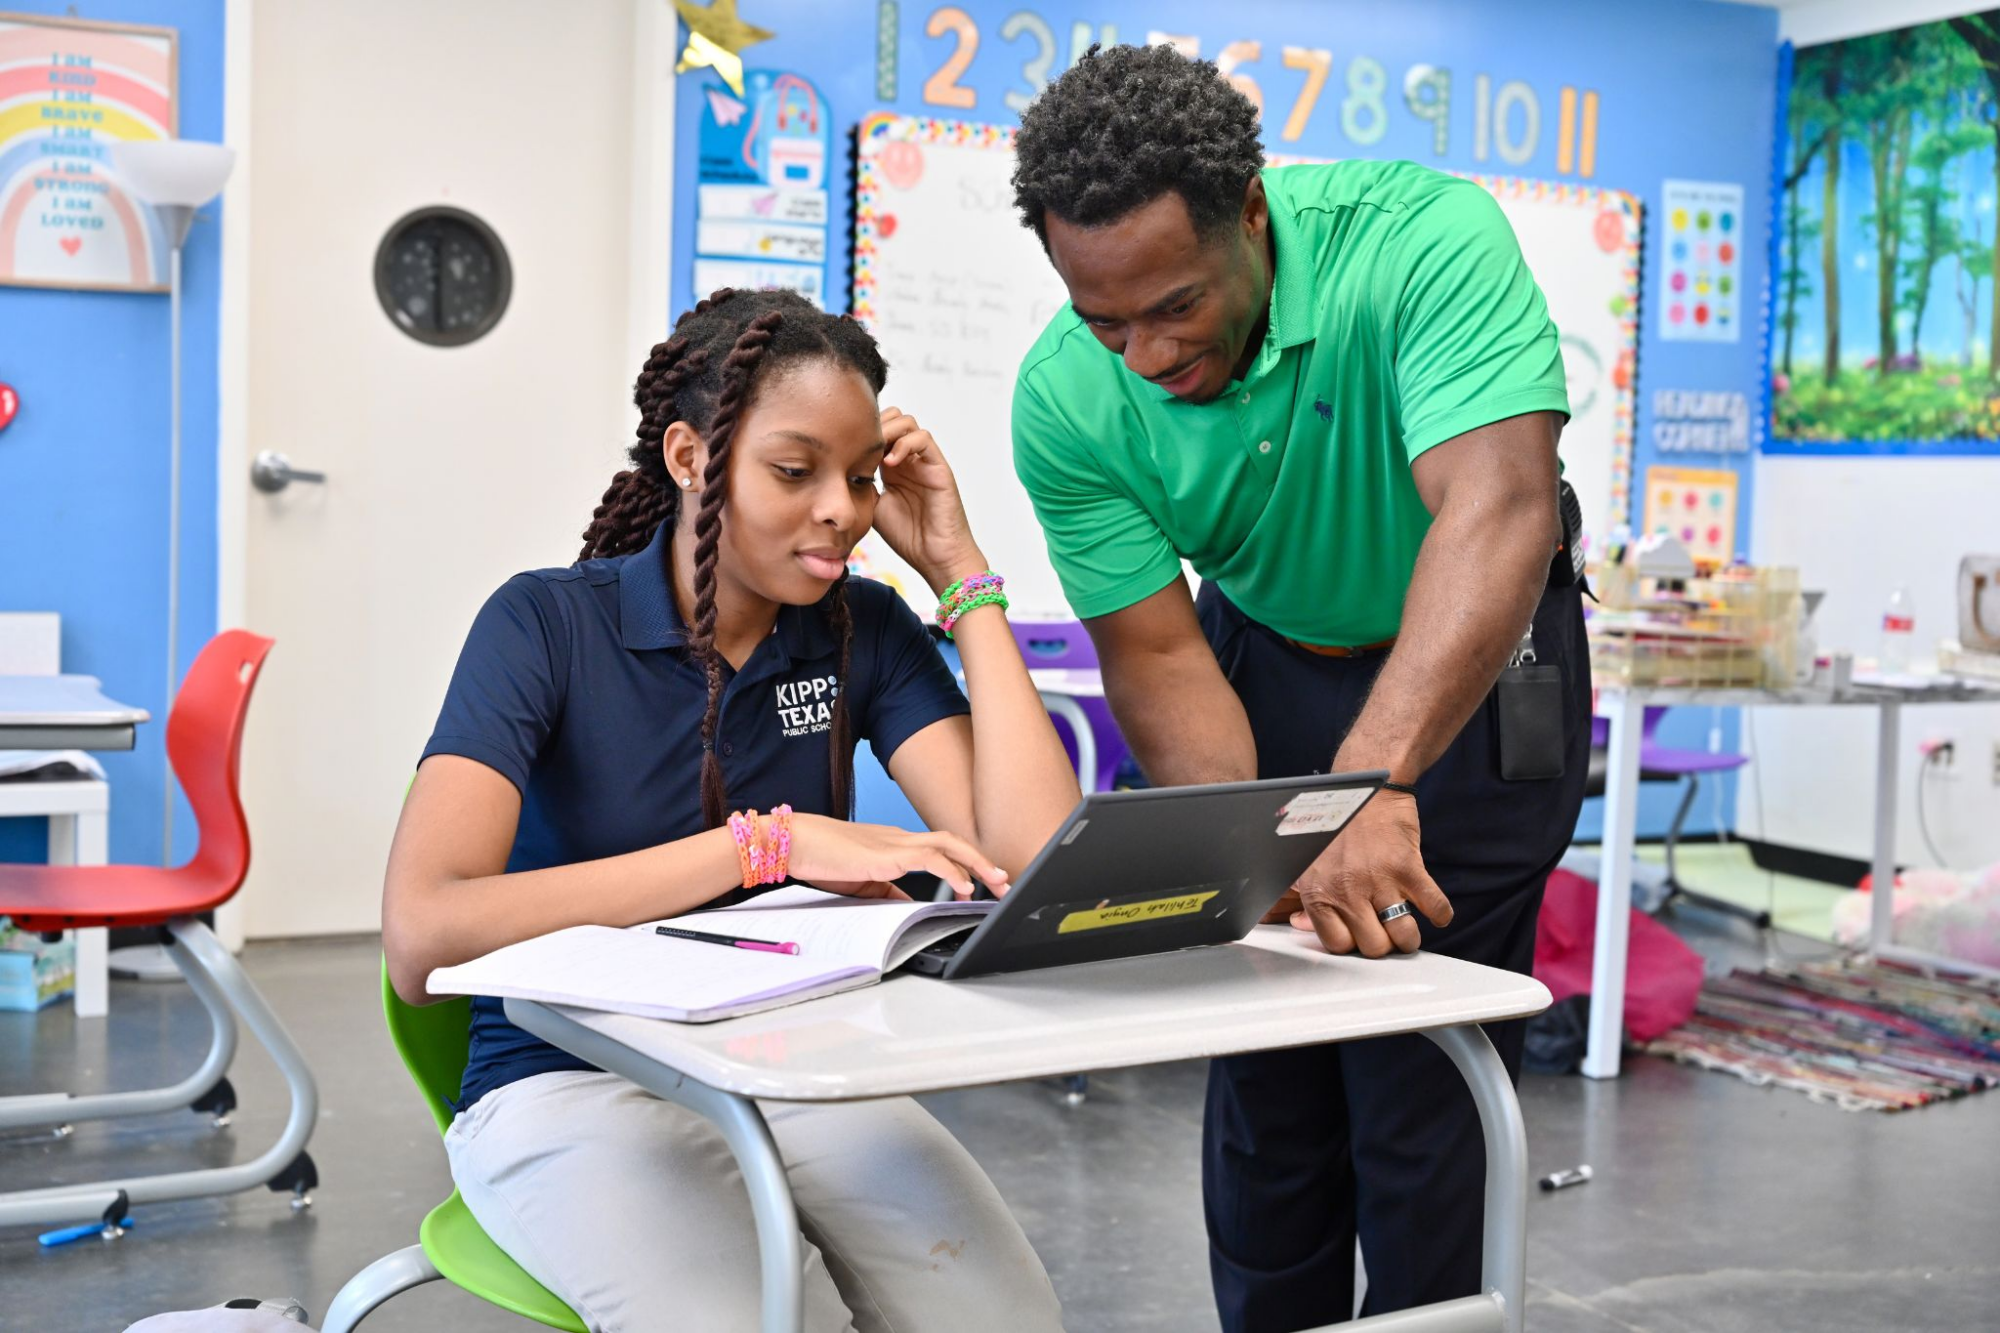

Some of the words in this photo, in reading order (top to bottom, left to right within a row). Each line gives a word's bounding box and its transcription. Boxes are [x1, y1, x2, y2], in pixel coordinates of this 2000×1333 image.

[923, 6, 979, 109] 2
[1001, 11, 1055, 113] 3
[1281, 46, 1332, 142] 7
[1340, 56, 1388, 146] 8
[1403, 63, 1451, 157] 9
[1474, 73, 1540, 166] 10
[1557, 86, 1598, 178] 11
[778, 700, 836, 728] TEXA
[782, 726, 809, 737] PUBLIC
[811, 721, 832, 733] SCHO
